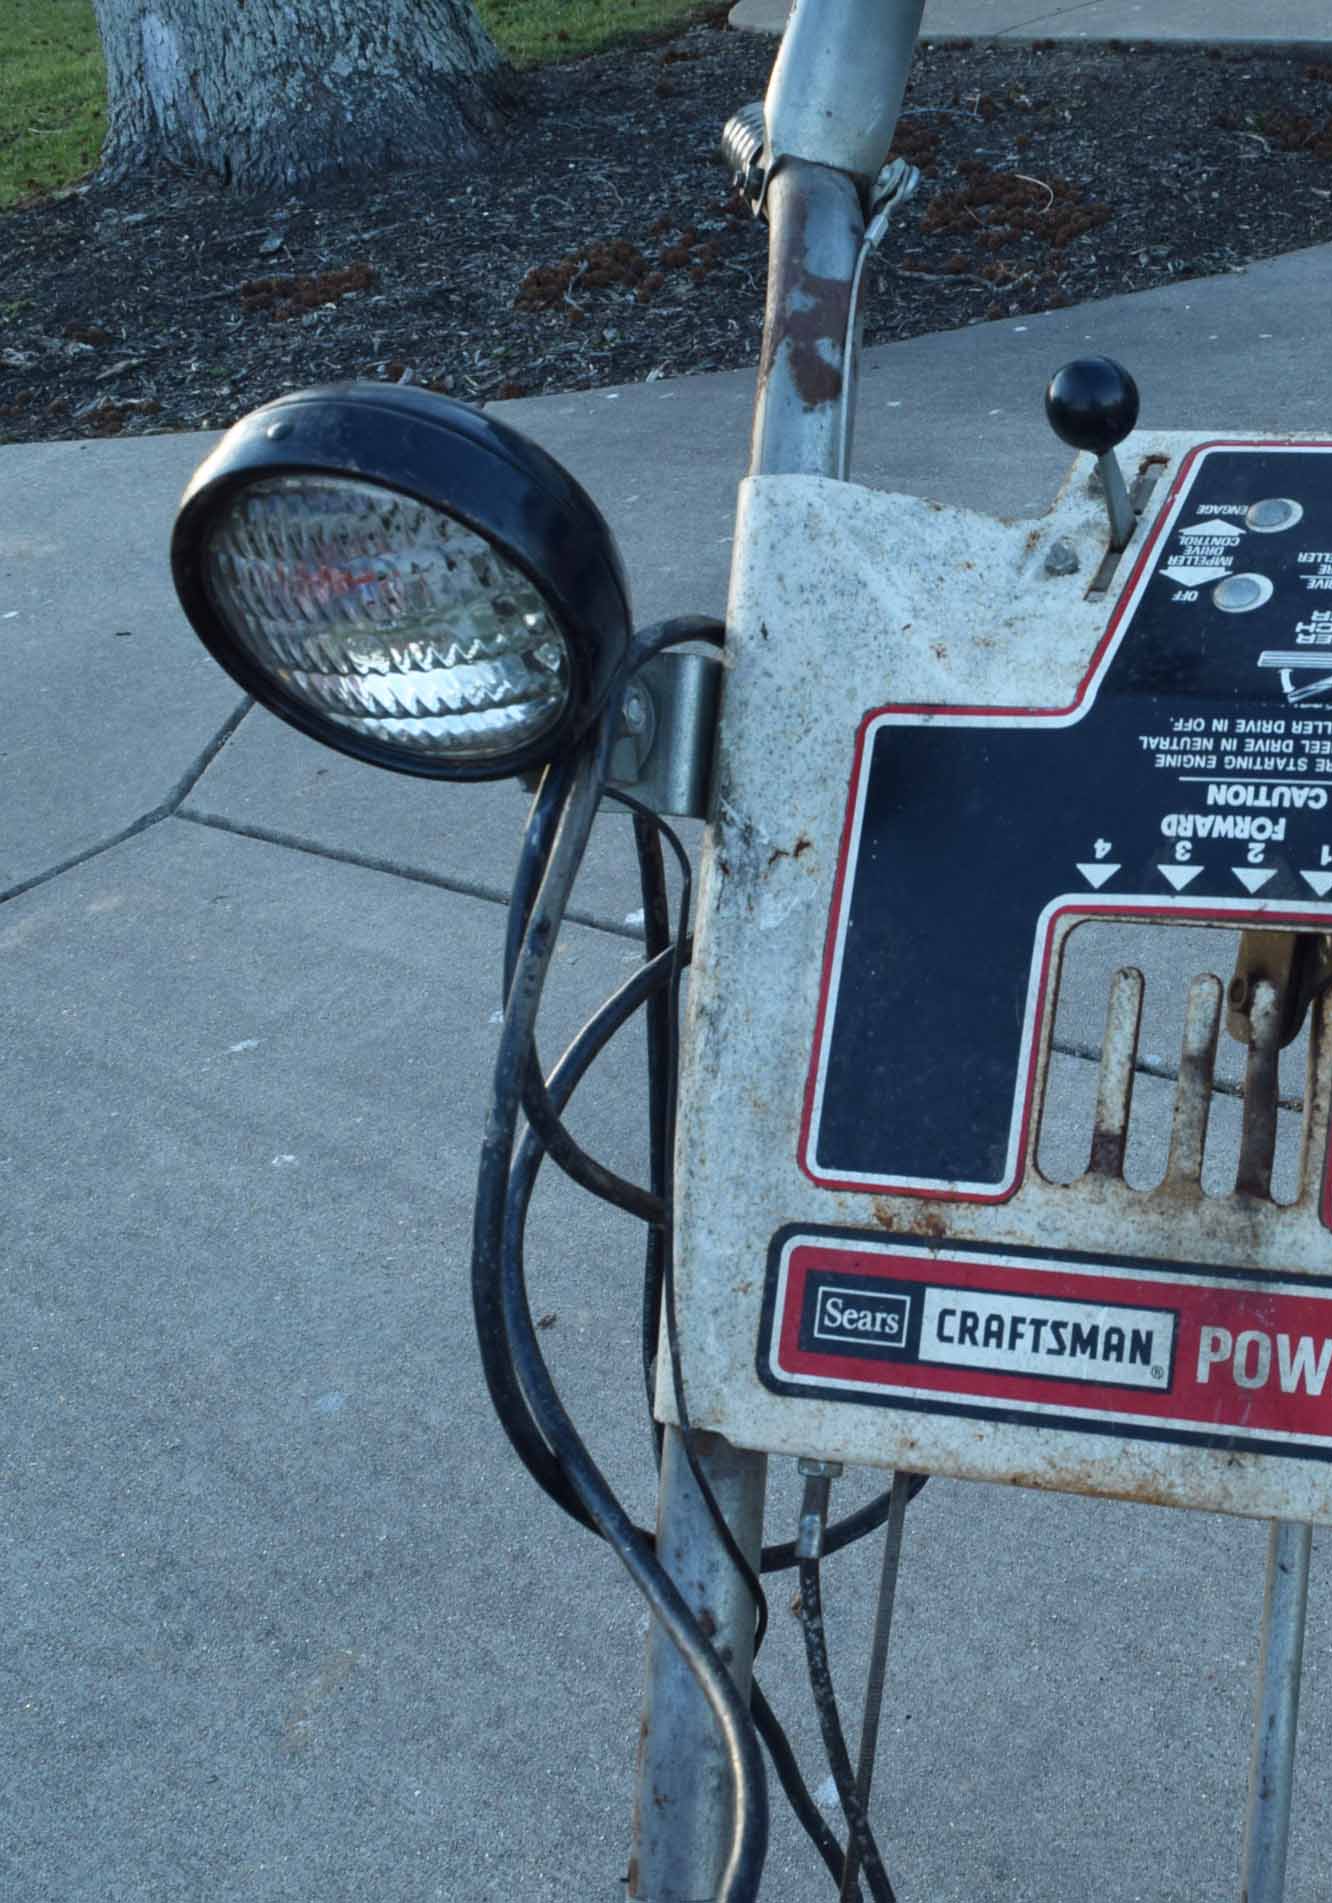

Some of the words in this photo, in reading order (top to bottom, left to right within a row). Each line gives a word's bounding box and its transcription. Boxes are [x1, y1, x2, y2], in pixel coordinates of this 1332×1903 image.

[1196, 504, 1249, 515] ENGAGE
[1180, 536, 1240, 546] CONTROL
[1184, 546, 1224, 555] DRIVE
[1167, 556, 1234, 566] IMPELLER
[1171, 590, 1198, 601] OFF
[1171, 717, 1206, 732] OFF.
[1211, 718, 1229, 732] IN
[1236, 719, 1286, 734] DRIVE
[1138, 736, 1214, 751] NEUTRAL
[1220, 738, 1238, 752] IN
[1244, 739, 1294, 754] DRIVE
[1154, 754, 1217, 769] ENGINE
[1224, 756, 1308, 772] STARTING
[1207, 784, 1328, 809] CAUTION
[1160, 814, 1286, 841] FORWARD
[1093, 838, 1112, 859] 4
[1175, 840, 1192, 862] 3
[1248, 842, 1266, 863] 2
[824, 1297, 900, 1335] Sears
